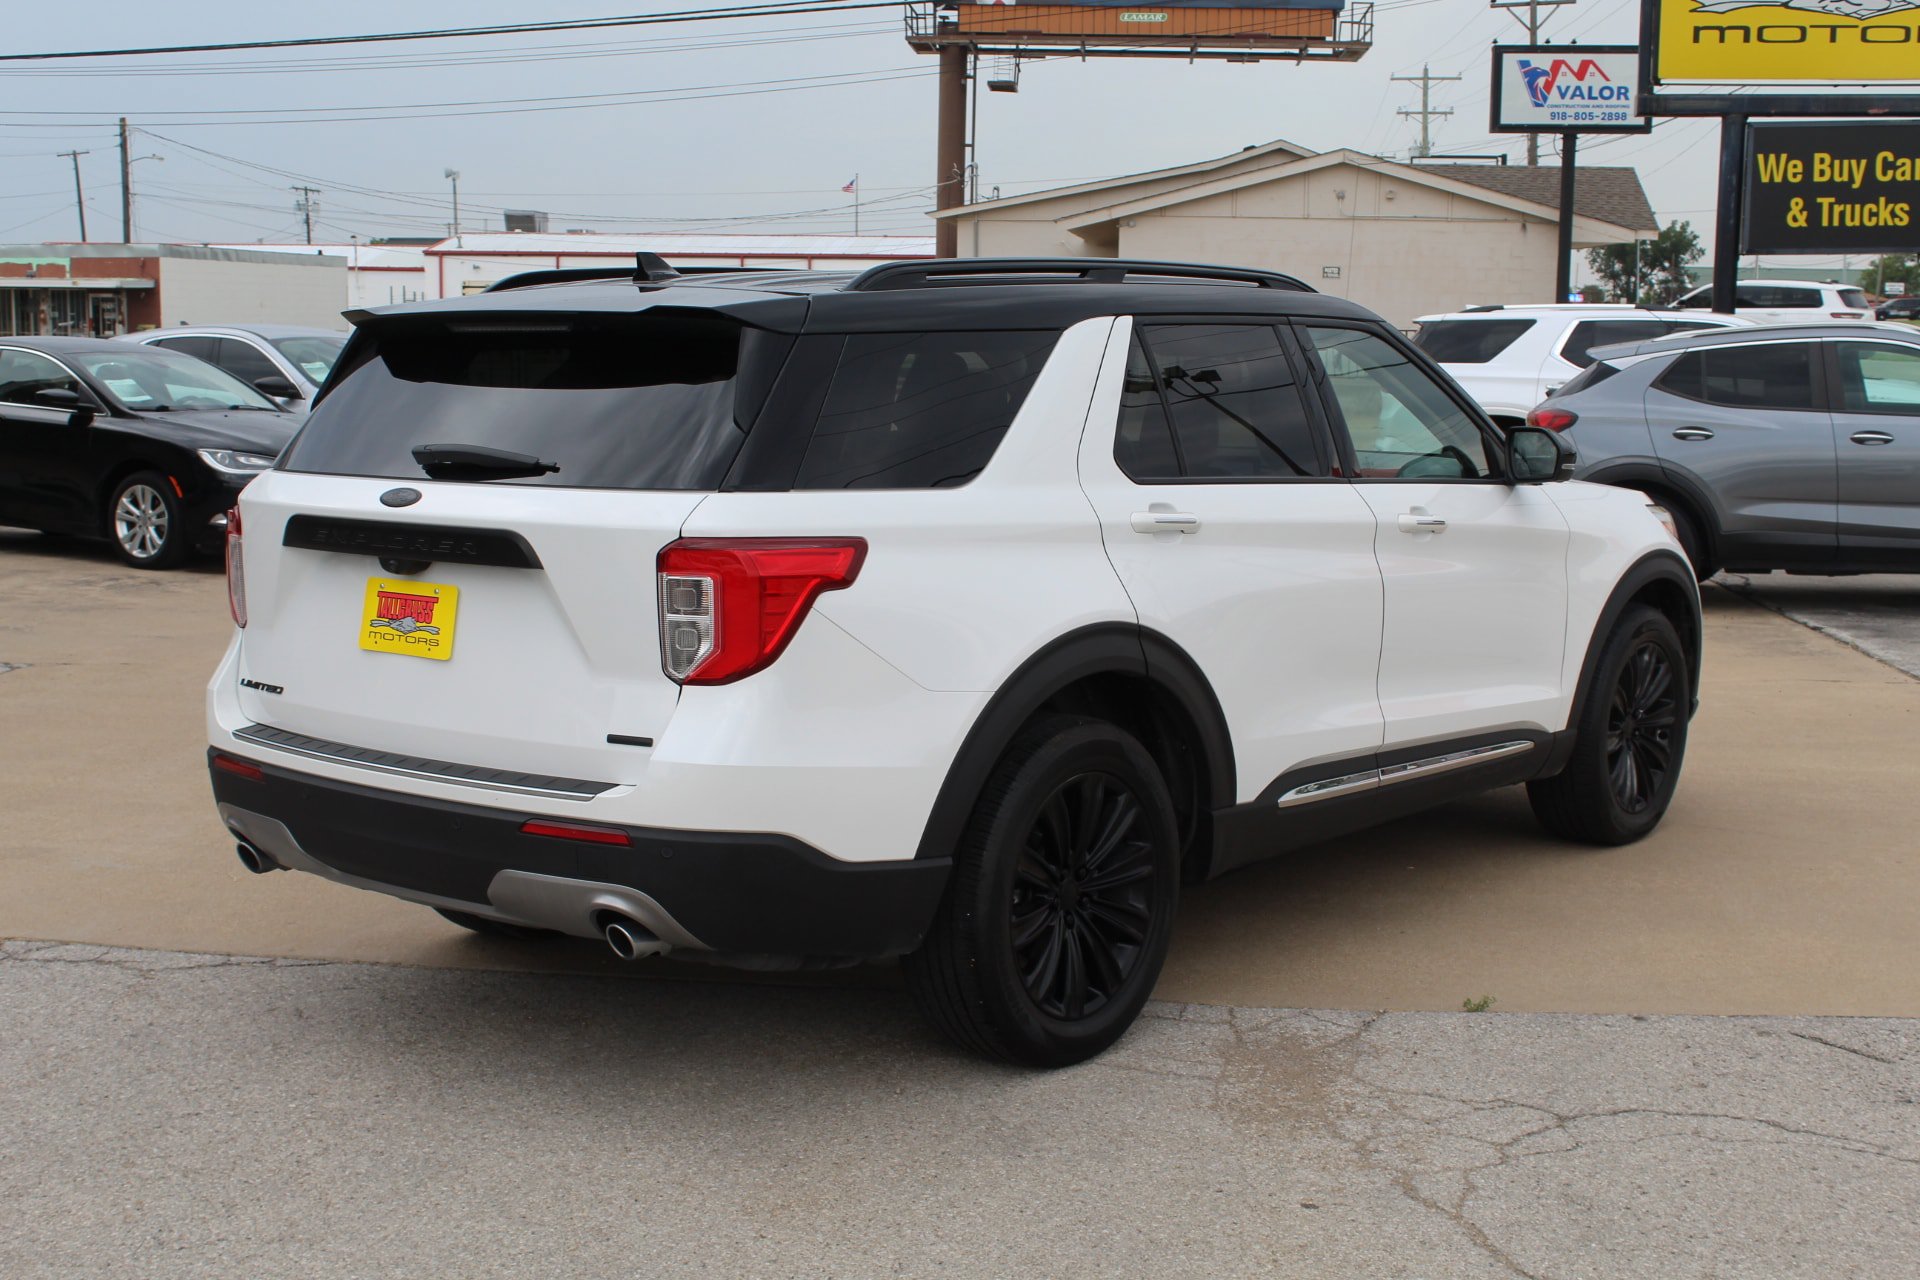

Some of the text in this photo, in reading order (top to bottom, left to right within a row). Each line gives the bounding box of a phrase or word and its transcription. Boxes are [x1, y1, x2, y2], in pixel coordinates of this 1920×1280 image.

[1123, 13, 1163, 21] LAMAR
[1693, 24, 1920, 44] MOTO
[1556, 85, 1630, 101] VALOR
[1550, 111, 1628, 121] 918-805-2898
[1757, 153, 1803, 183] We
[1813, 152, 1867, 189] Buy
[1786, 196, 1910, 228] & Trucks
[368, 631, 440, 647] MOTORS
[240, 678, 284, 695] LIMITED
